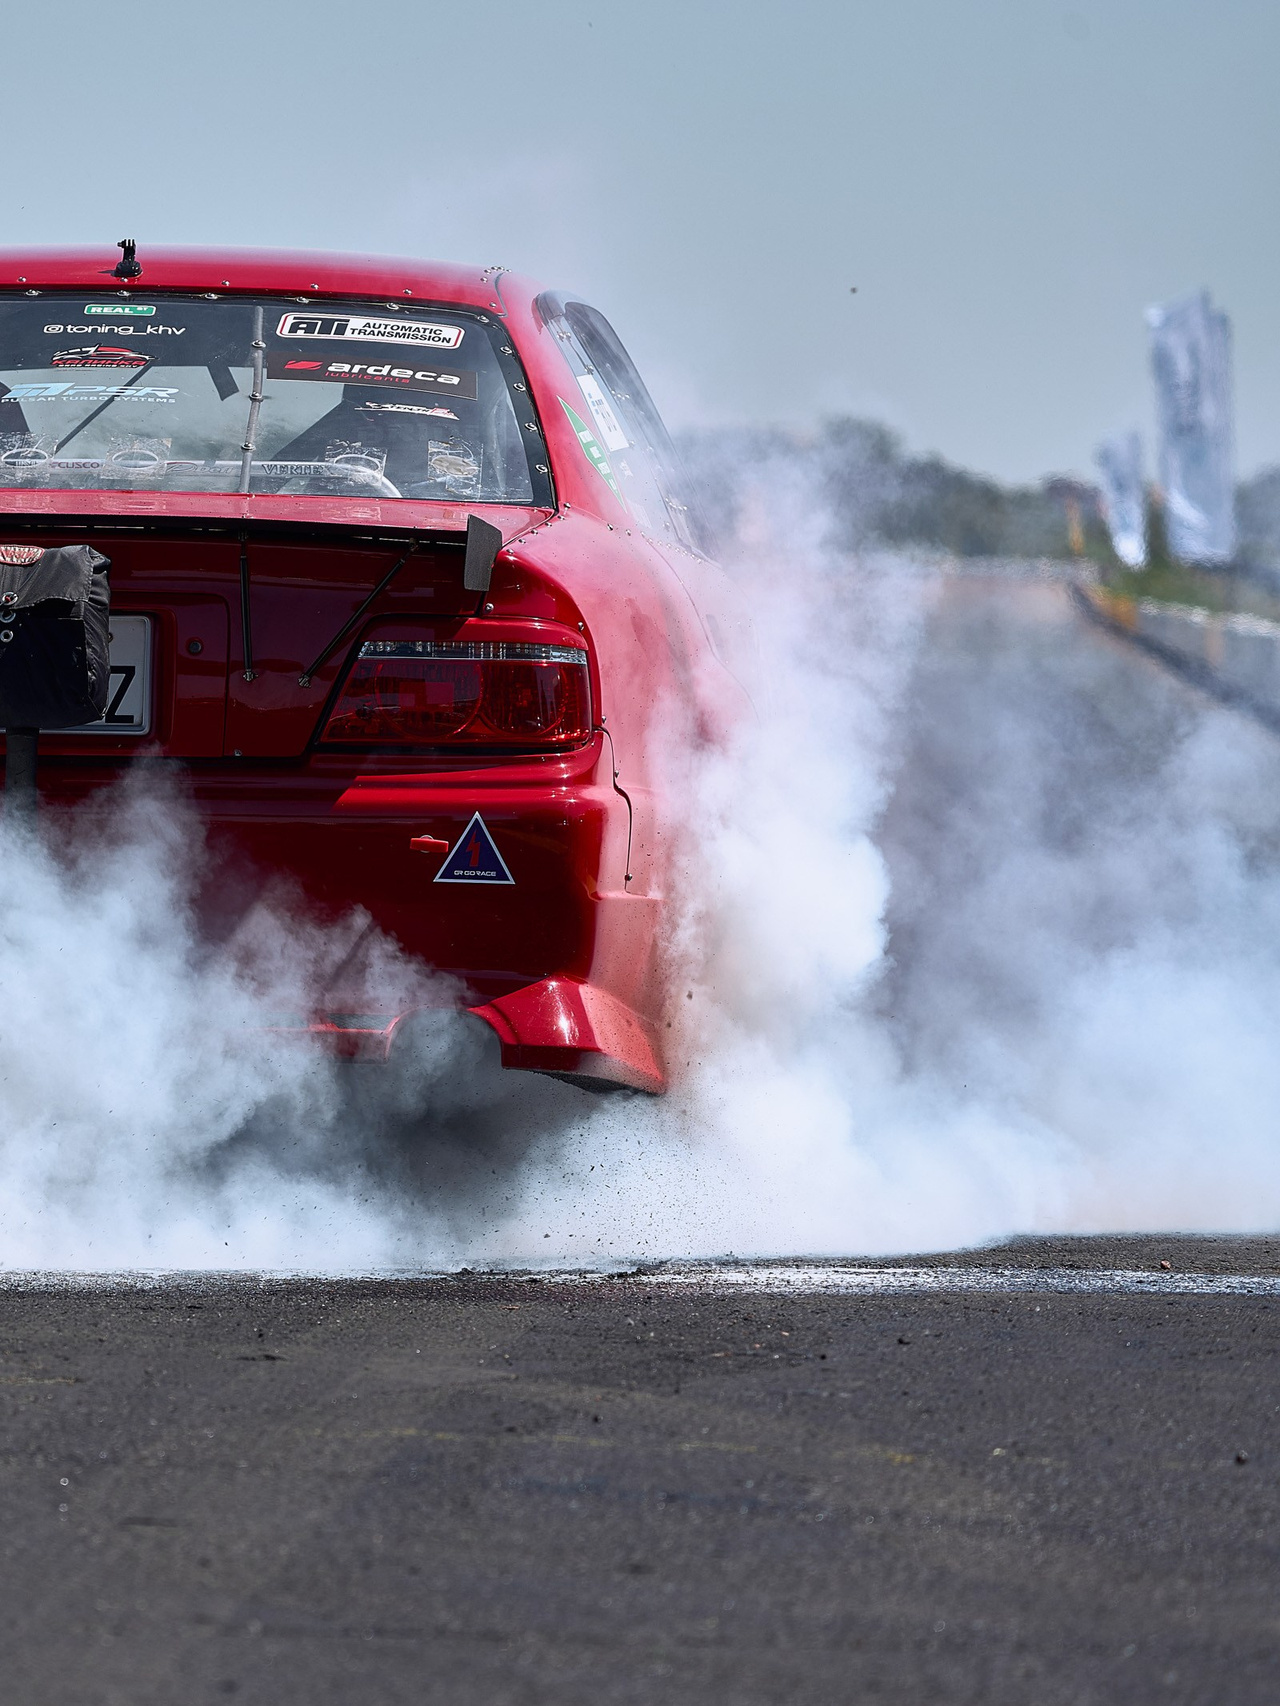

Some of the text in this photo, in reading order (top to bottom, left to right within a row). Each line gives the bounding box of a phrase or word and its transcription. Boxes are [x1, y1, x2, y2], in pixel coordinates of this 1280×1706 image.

[350, 327, 452, 344] TRANSMISSION
[362, 321, 443, 336] AUTOMATIC
[324, 371, 410, 384] lubricants
[327, 361, 461, 386] ardeca
[57, 461, 100, 469] CUSCO
